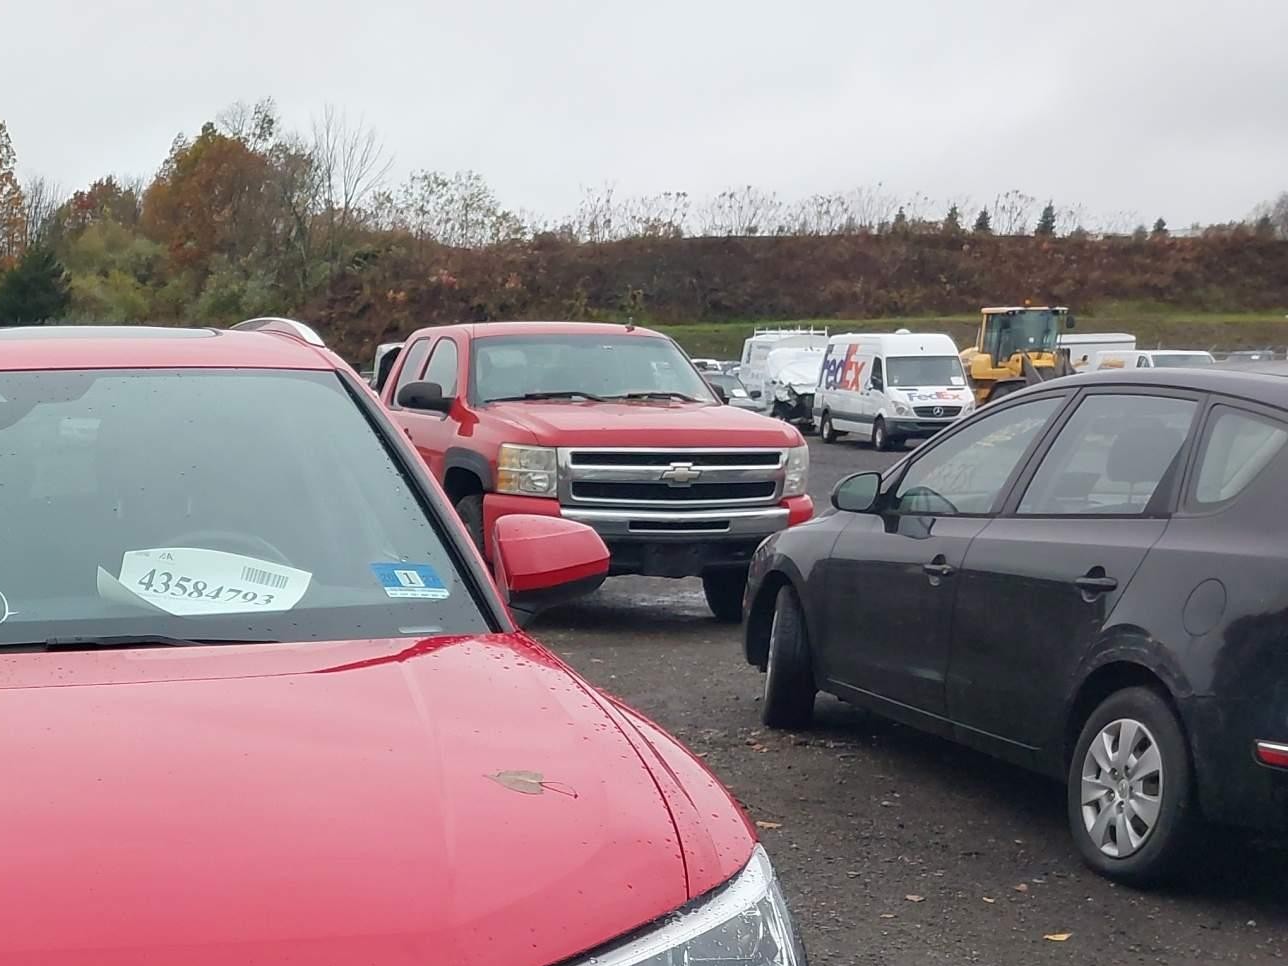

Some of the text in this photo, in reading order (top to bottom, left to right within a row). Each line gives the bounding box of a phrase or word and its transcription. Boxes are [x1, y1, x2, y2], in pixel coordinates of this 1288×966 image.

[818, 344, 865, 392] FedEx
[907, 391, 963, 402] FedEx
[137, 568, 276, 606] 43584793
[402, 572, 416, 585] 1
